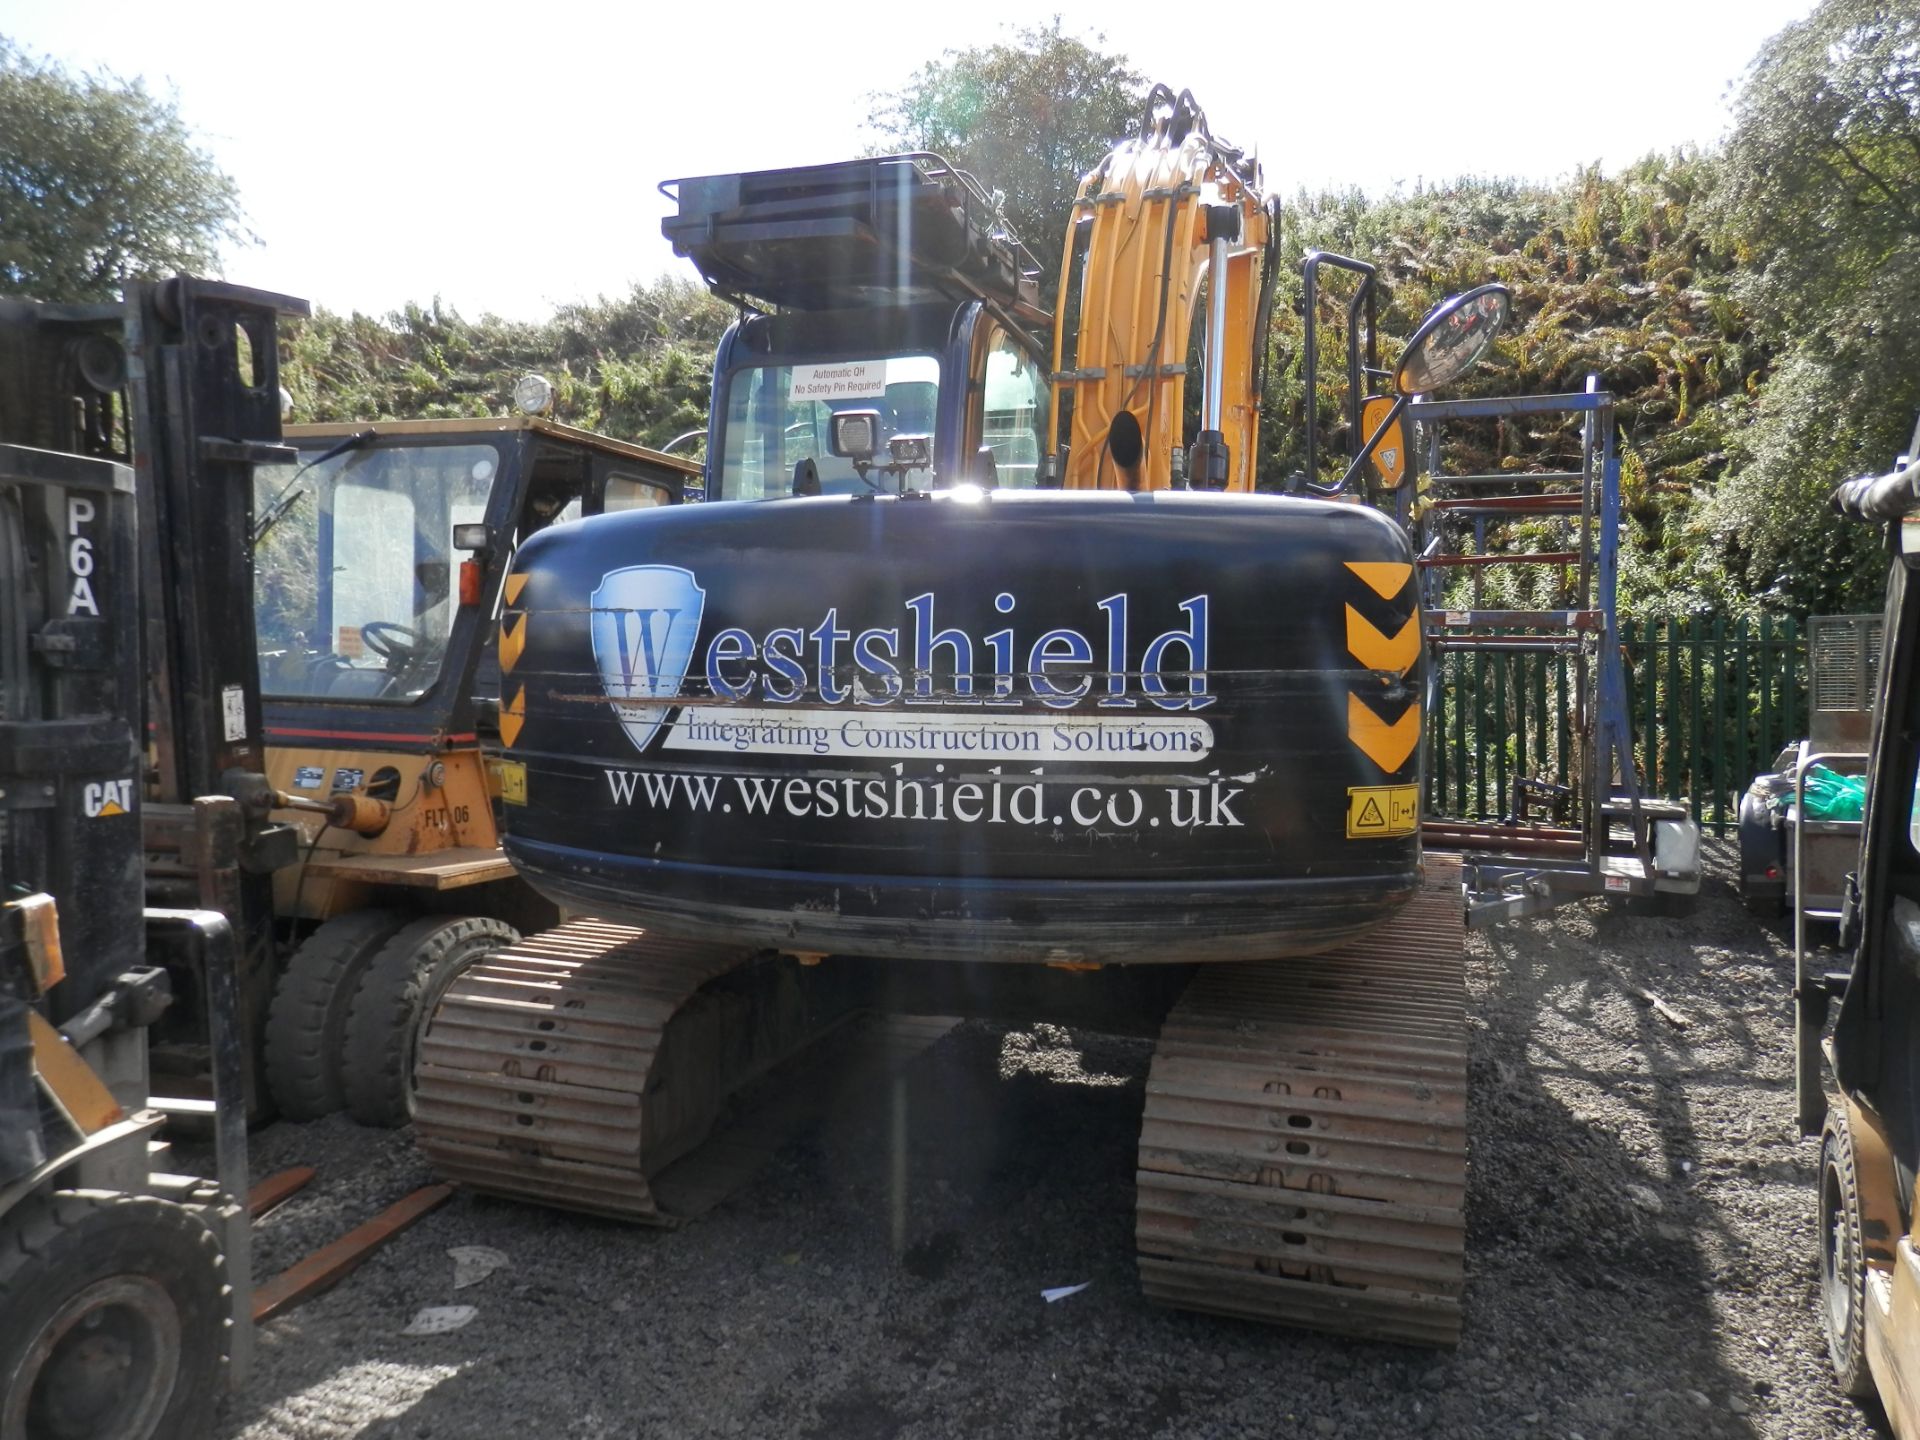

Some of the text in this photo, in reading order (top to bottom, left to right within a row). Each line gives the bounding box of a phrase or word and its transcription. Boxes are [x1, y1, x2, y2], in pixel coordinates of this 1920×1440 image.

[795, 379, 881, 395] No Safety Pin Required
[813, 367, 865, 379] Automatic QH
[686, 713, 1204, 754] Integrating Construction Solutions
[84, 779, 133, 817] CAT
[604, 762, 1245, 828] www.westshield.co.uk
[425, 805, 470, 828] FLT 06
